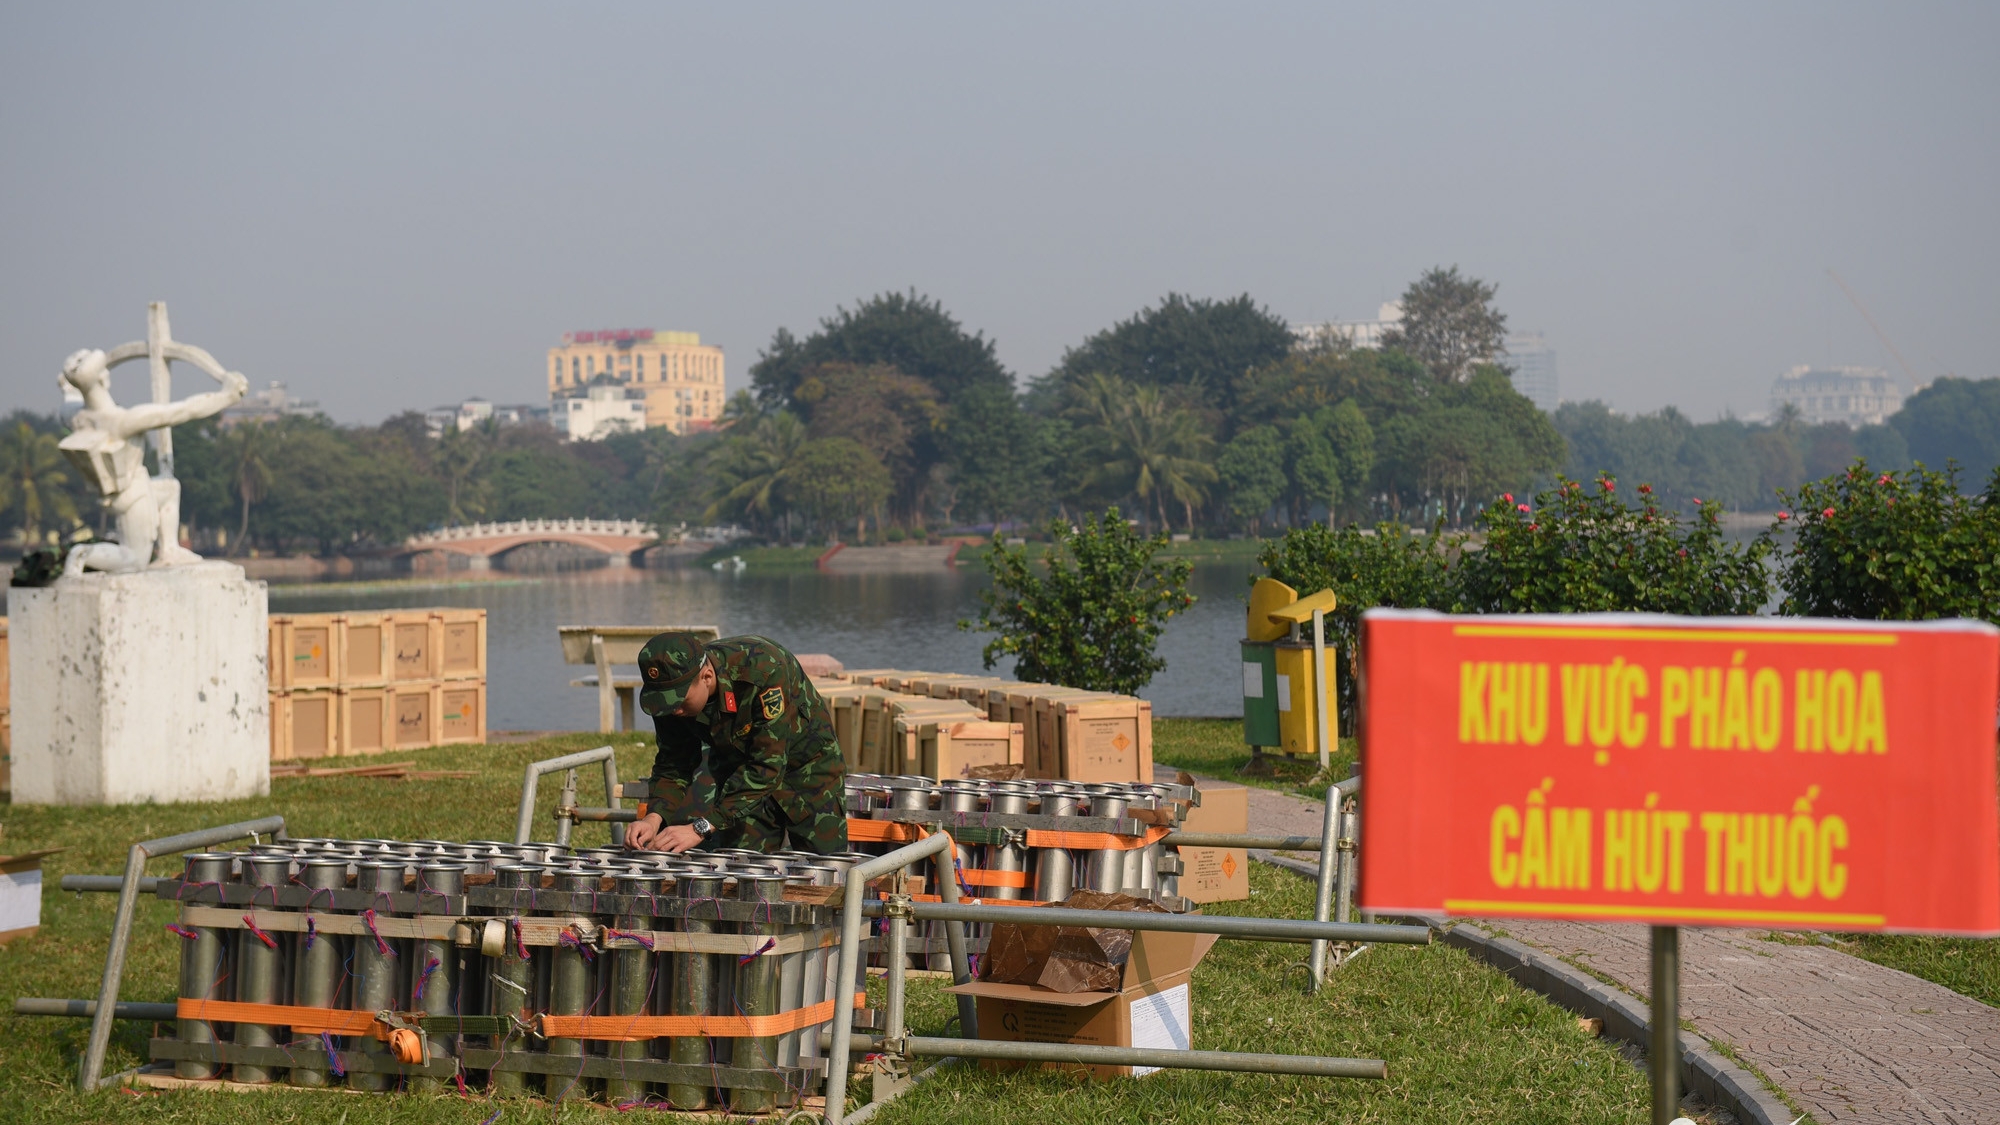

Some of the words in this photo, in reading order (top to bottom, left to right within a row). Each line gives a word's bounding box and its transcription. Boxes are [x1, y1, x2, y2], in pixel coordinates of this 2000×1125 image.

[1459, 662, 1548, 746] KHU
[1562, 657, 1649, 767] VỰC
[1661, 650, 1781, 752] PHÁO
[1795, 670, 1887, 755] HOA
[1490, 778, 1591, 891] CẤM
[1604, 793, 1690, 893] HÚT
[1701, 786, 1847, 899] THUỐC
